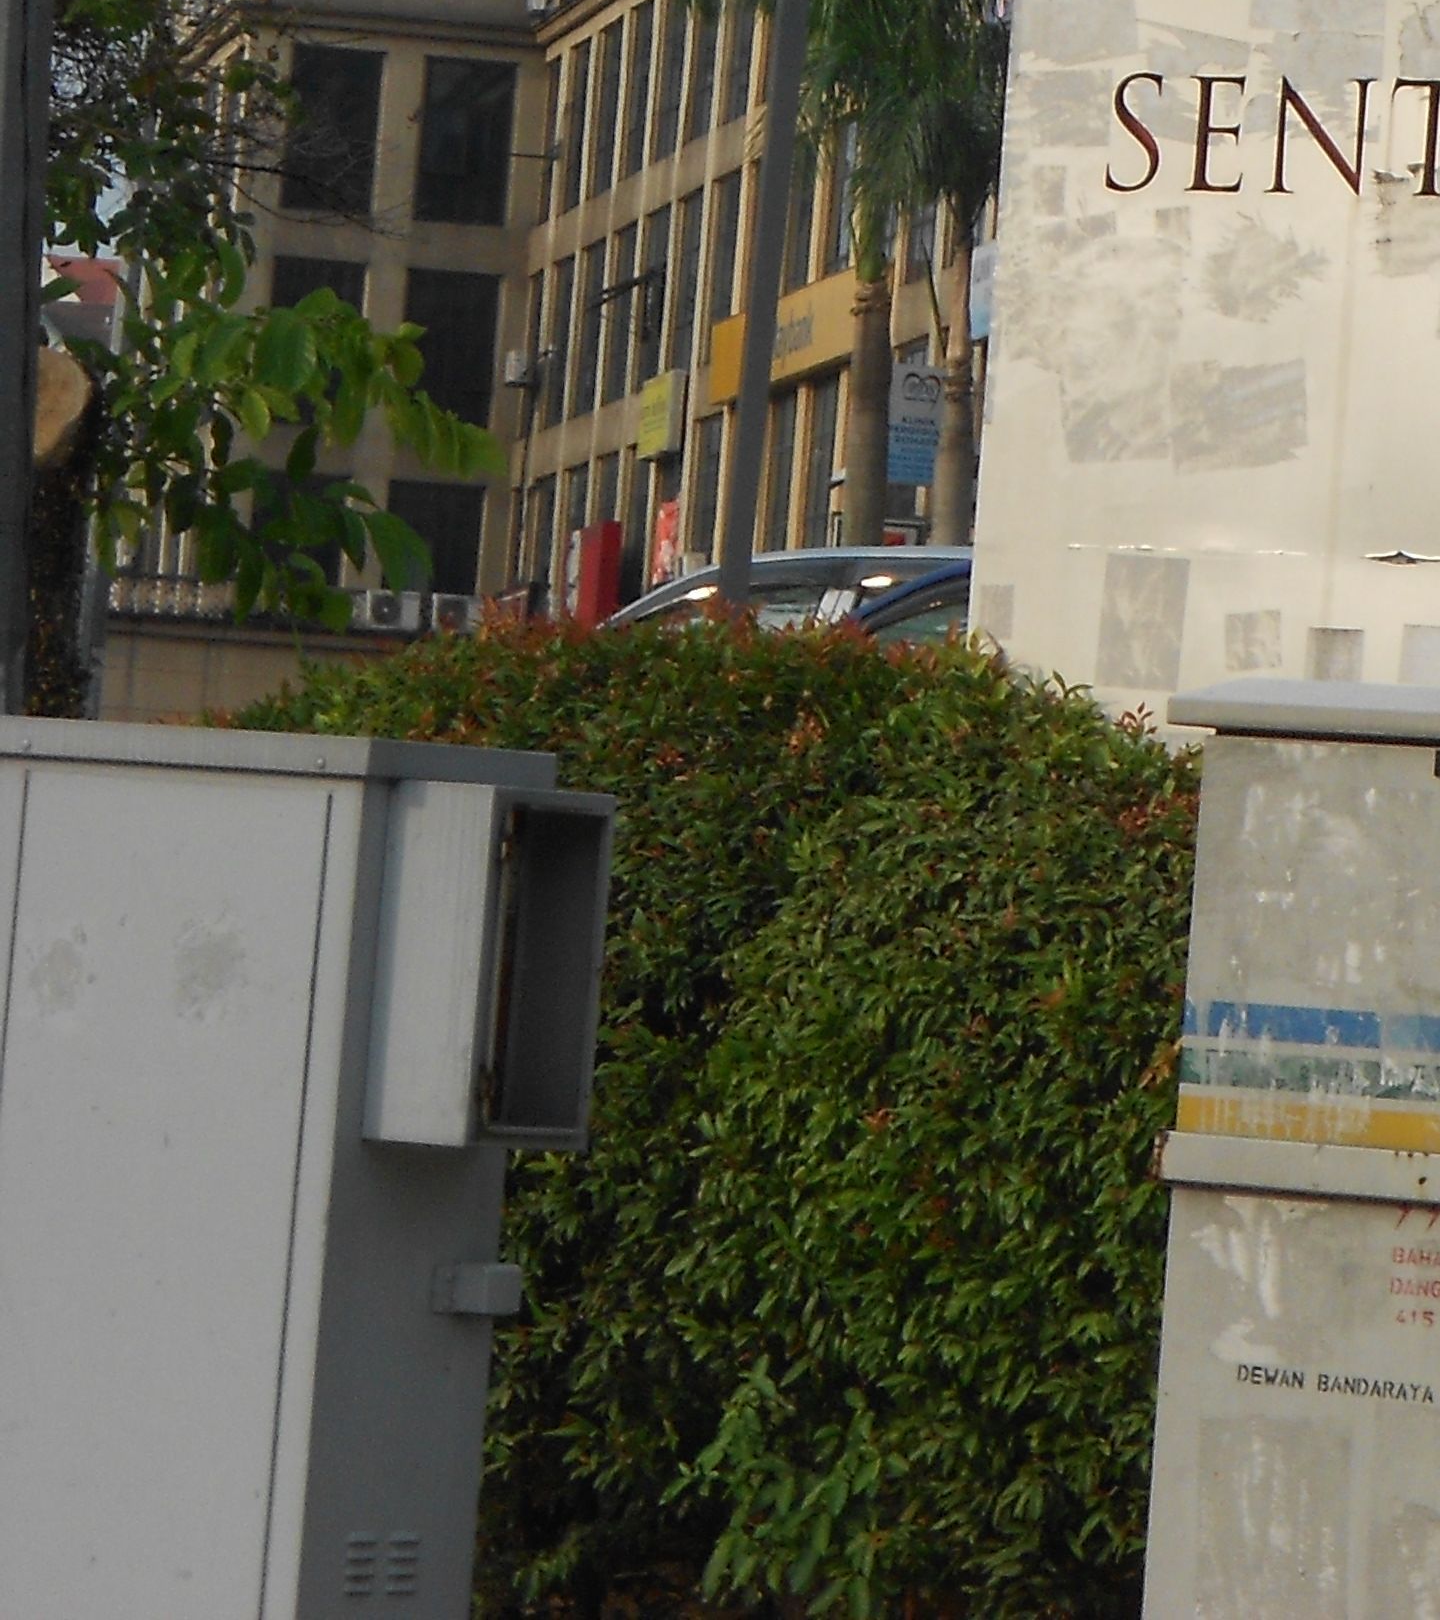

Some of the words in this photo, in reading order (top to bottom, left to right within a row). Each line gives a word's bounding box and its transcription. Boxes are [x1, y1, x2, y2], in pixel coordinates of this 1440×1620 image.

[1396, 1310, 1434, 1328] 415
[1236, 1363, 1305, 1391] DEWAN
[1316, 1373, 1435, 1405] BANDARAYA
